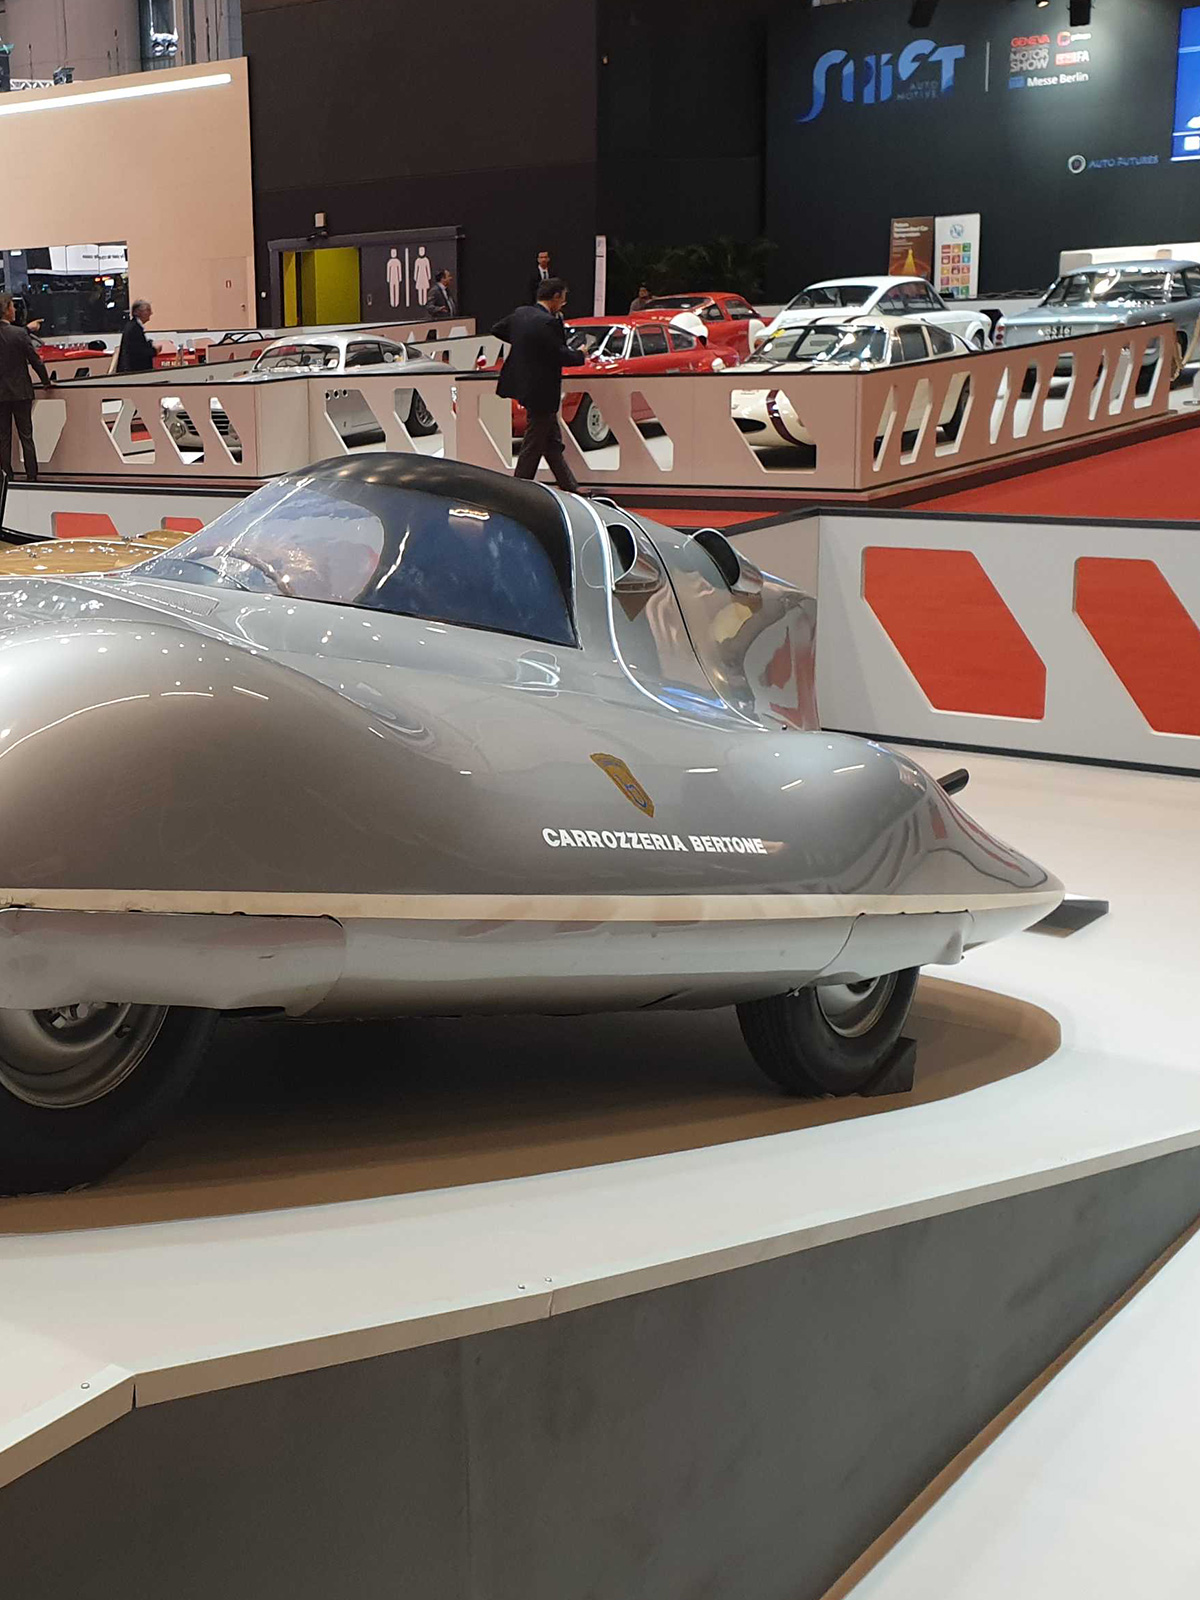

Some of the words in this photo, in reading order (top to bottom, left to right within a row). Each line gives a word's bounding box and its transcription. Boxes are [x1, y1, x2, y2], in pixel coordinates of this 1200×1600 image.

[1010, 48, 1049, 61] MOTOR
[1010, 59, 1049, 72] SHOW
[1027, 76, 1058, 87] Messe
[1059, 71, 1089, 83] Berlin
[541, 828, 689, 852] CARROZZERIA
[688, 835, 768, 855] BERTONE
